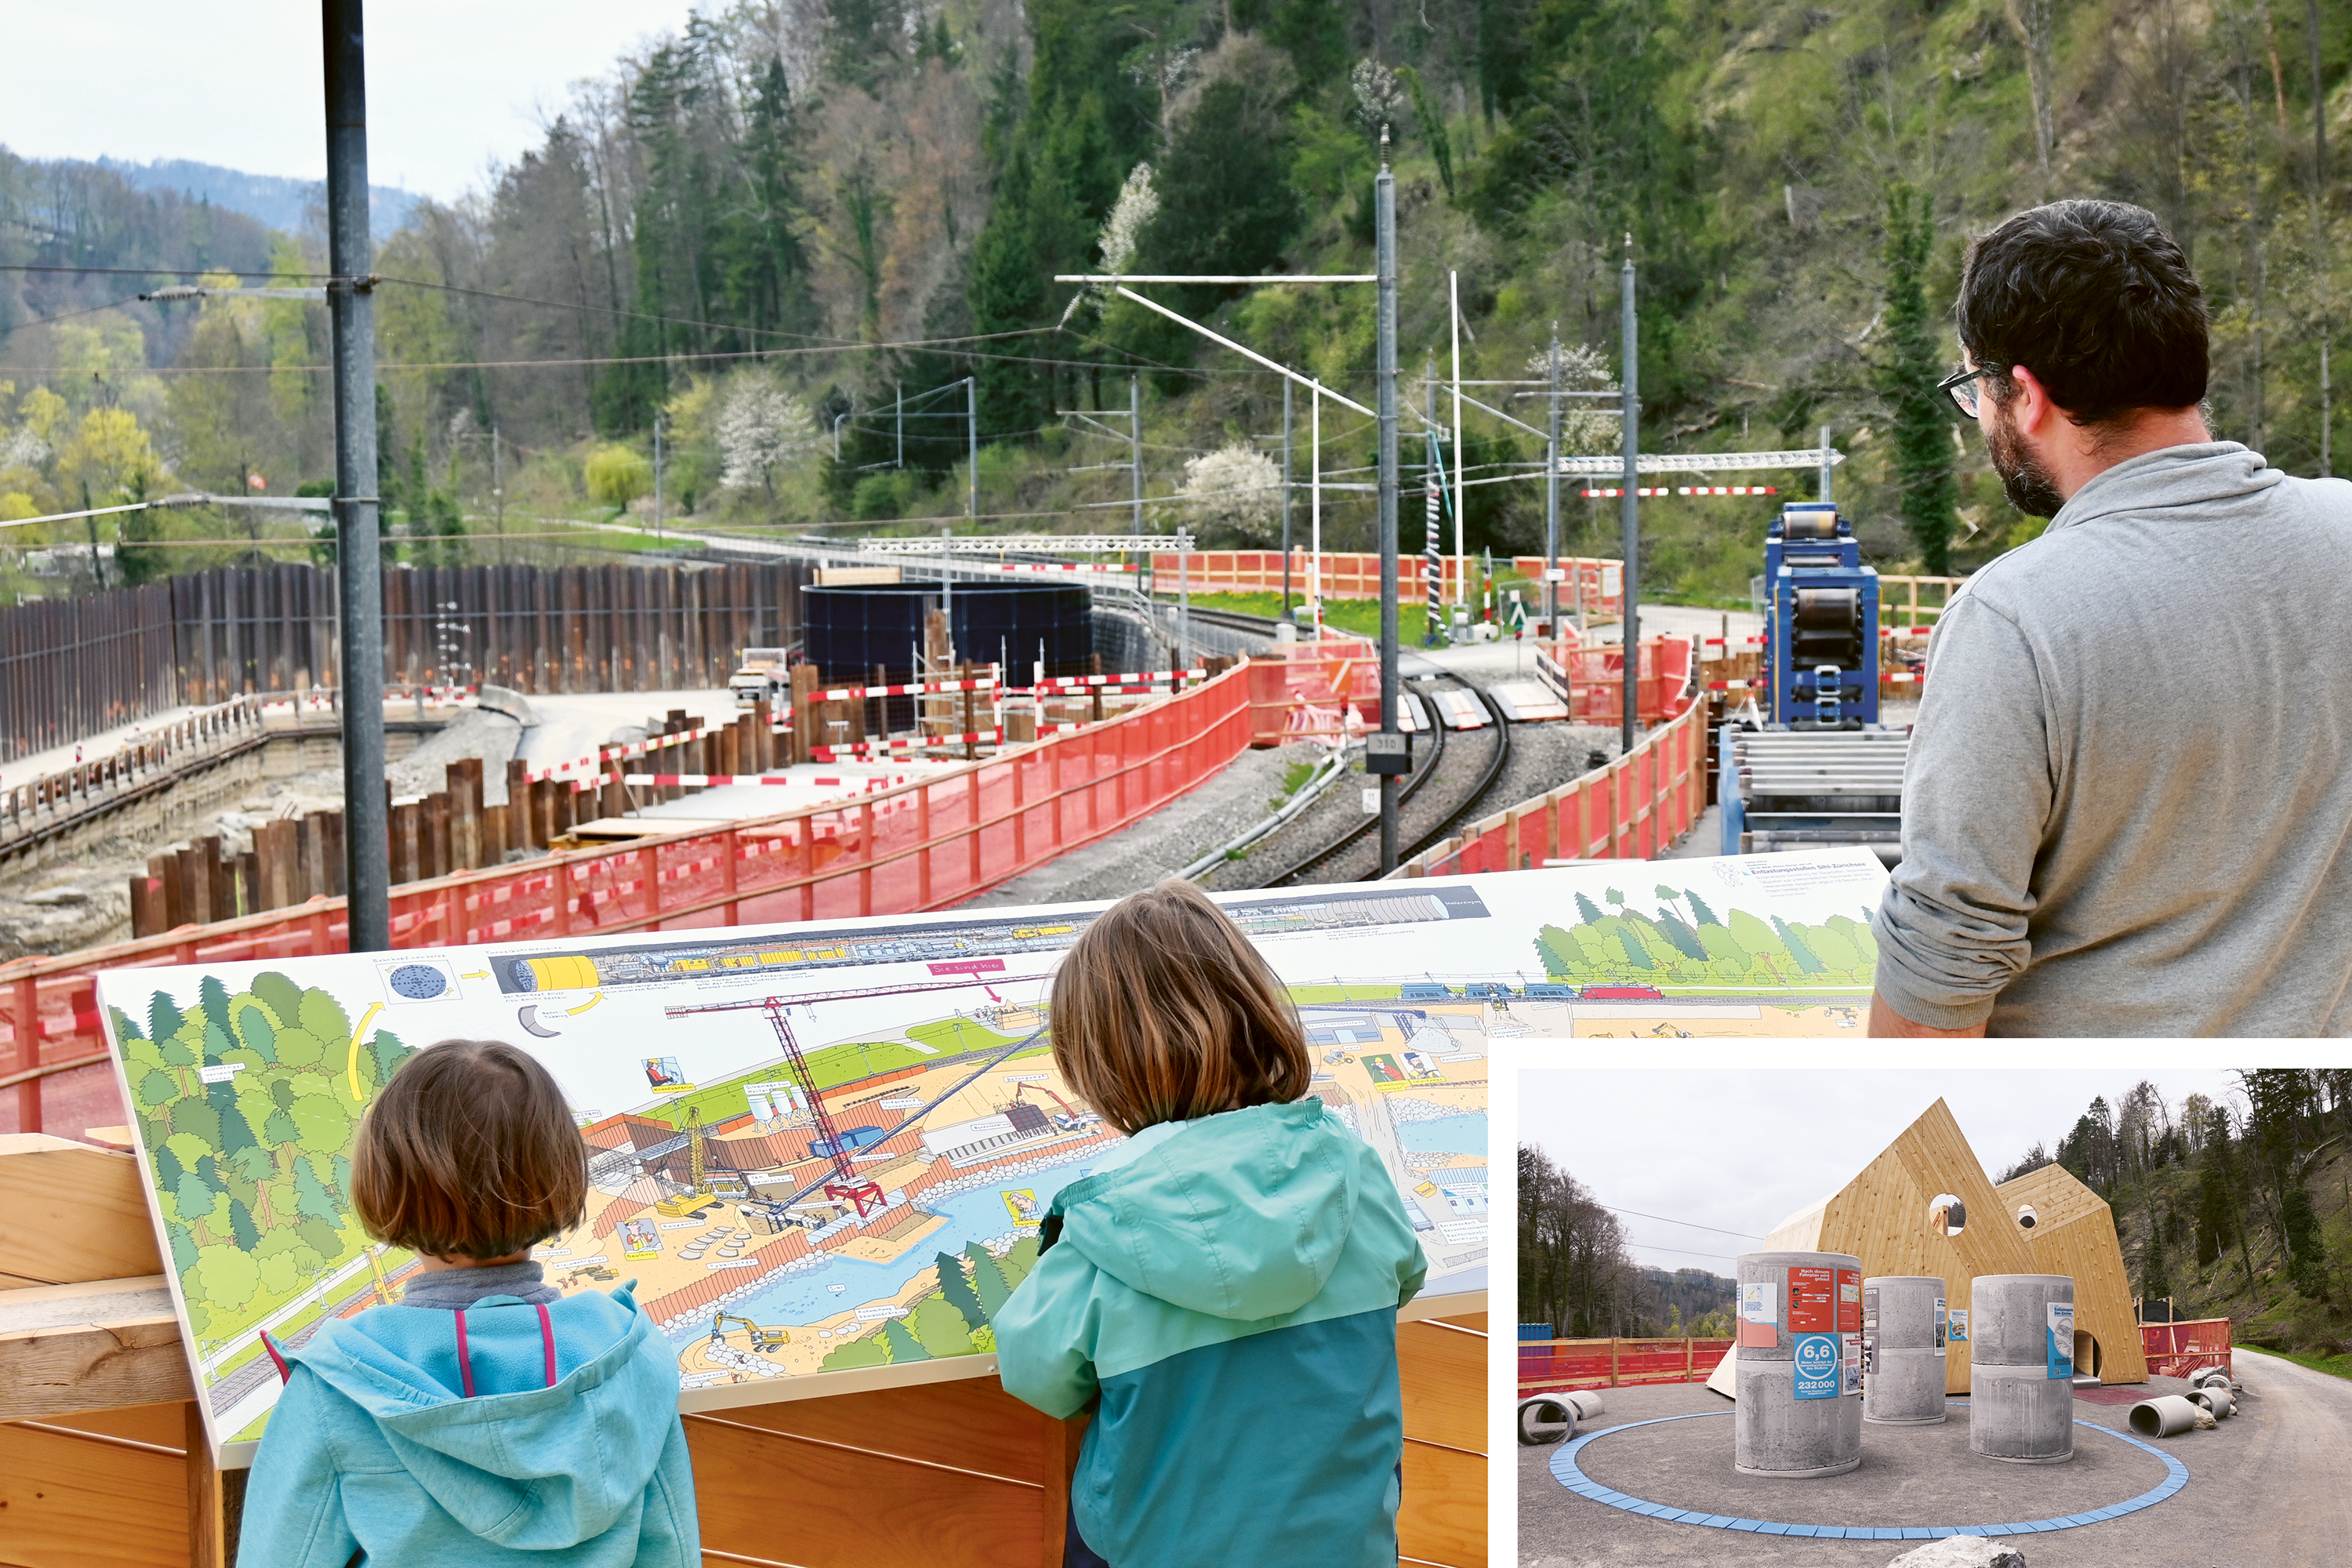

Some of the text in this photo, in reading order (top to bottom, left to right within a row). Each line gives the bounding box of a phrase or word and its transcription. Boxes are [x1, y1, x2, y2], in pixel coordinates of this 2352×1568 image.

[1751, 865, 1817, 875] Entlastungsstollen
[485, 946, 563, 956] Tunnelbohrmaschine
[372, 954, 408, 964] Bohrkopf
[933, 964, 951, 973] Sie
[954, 963, 978, 972] sind
[1803, 1345, 1830, 1361] 6,6
